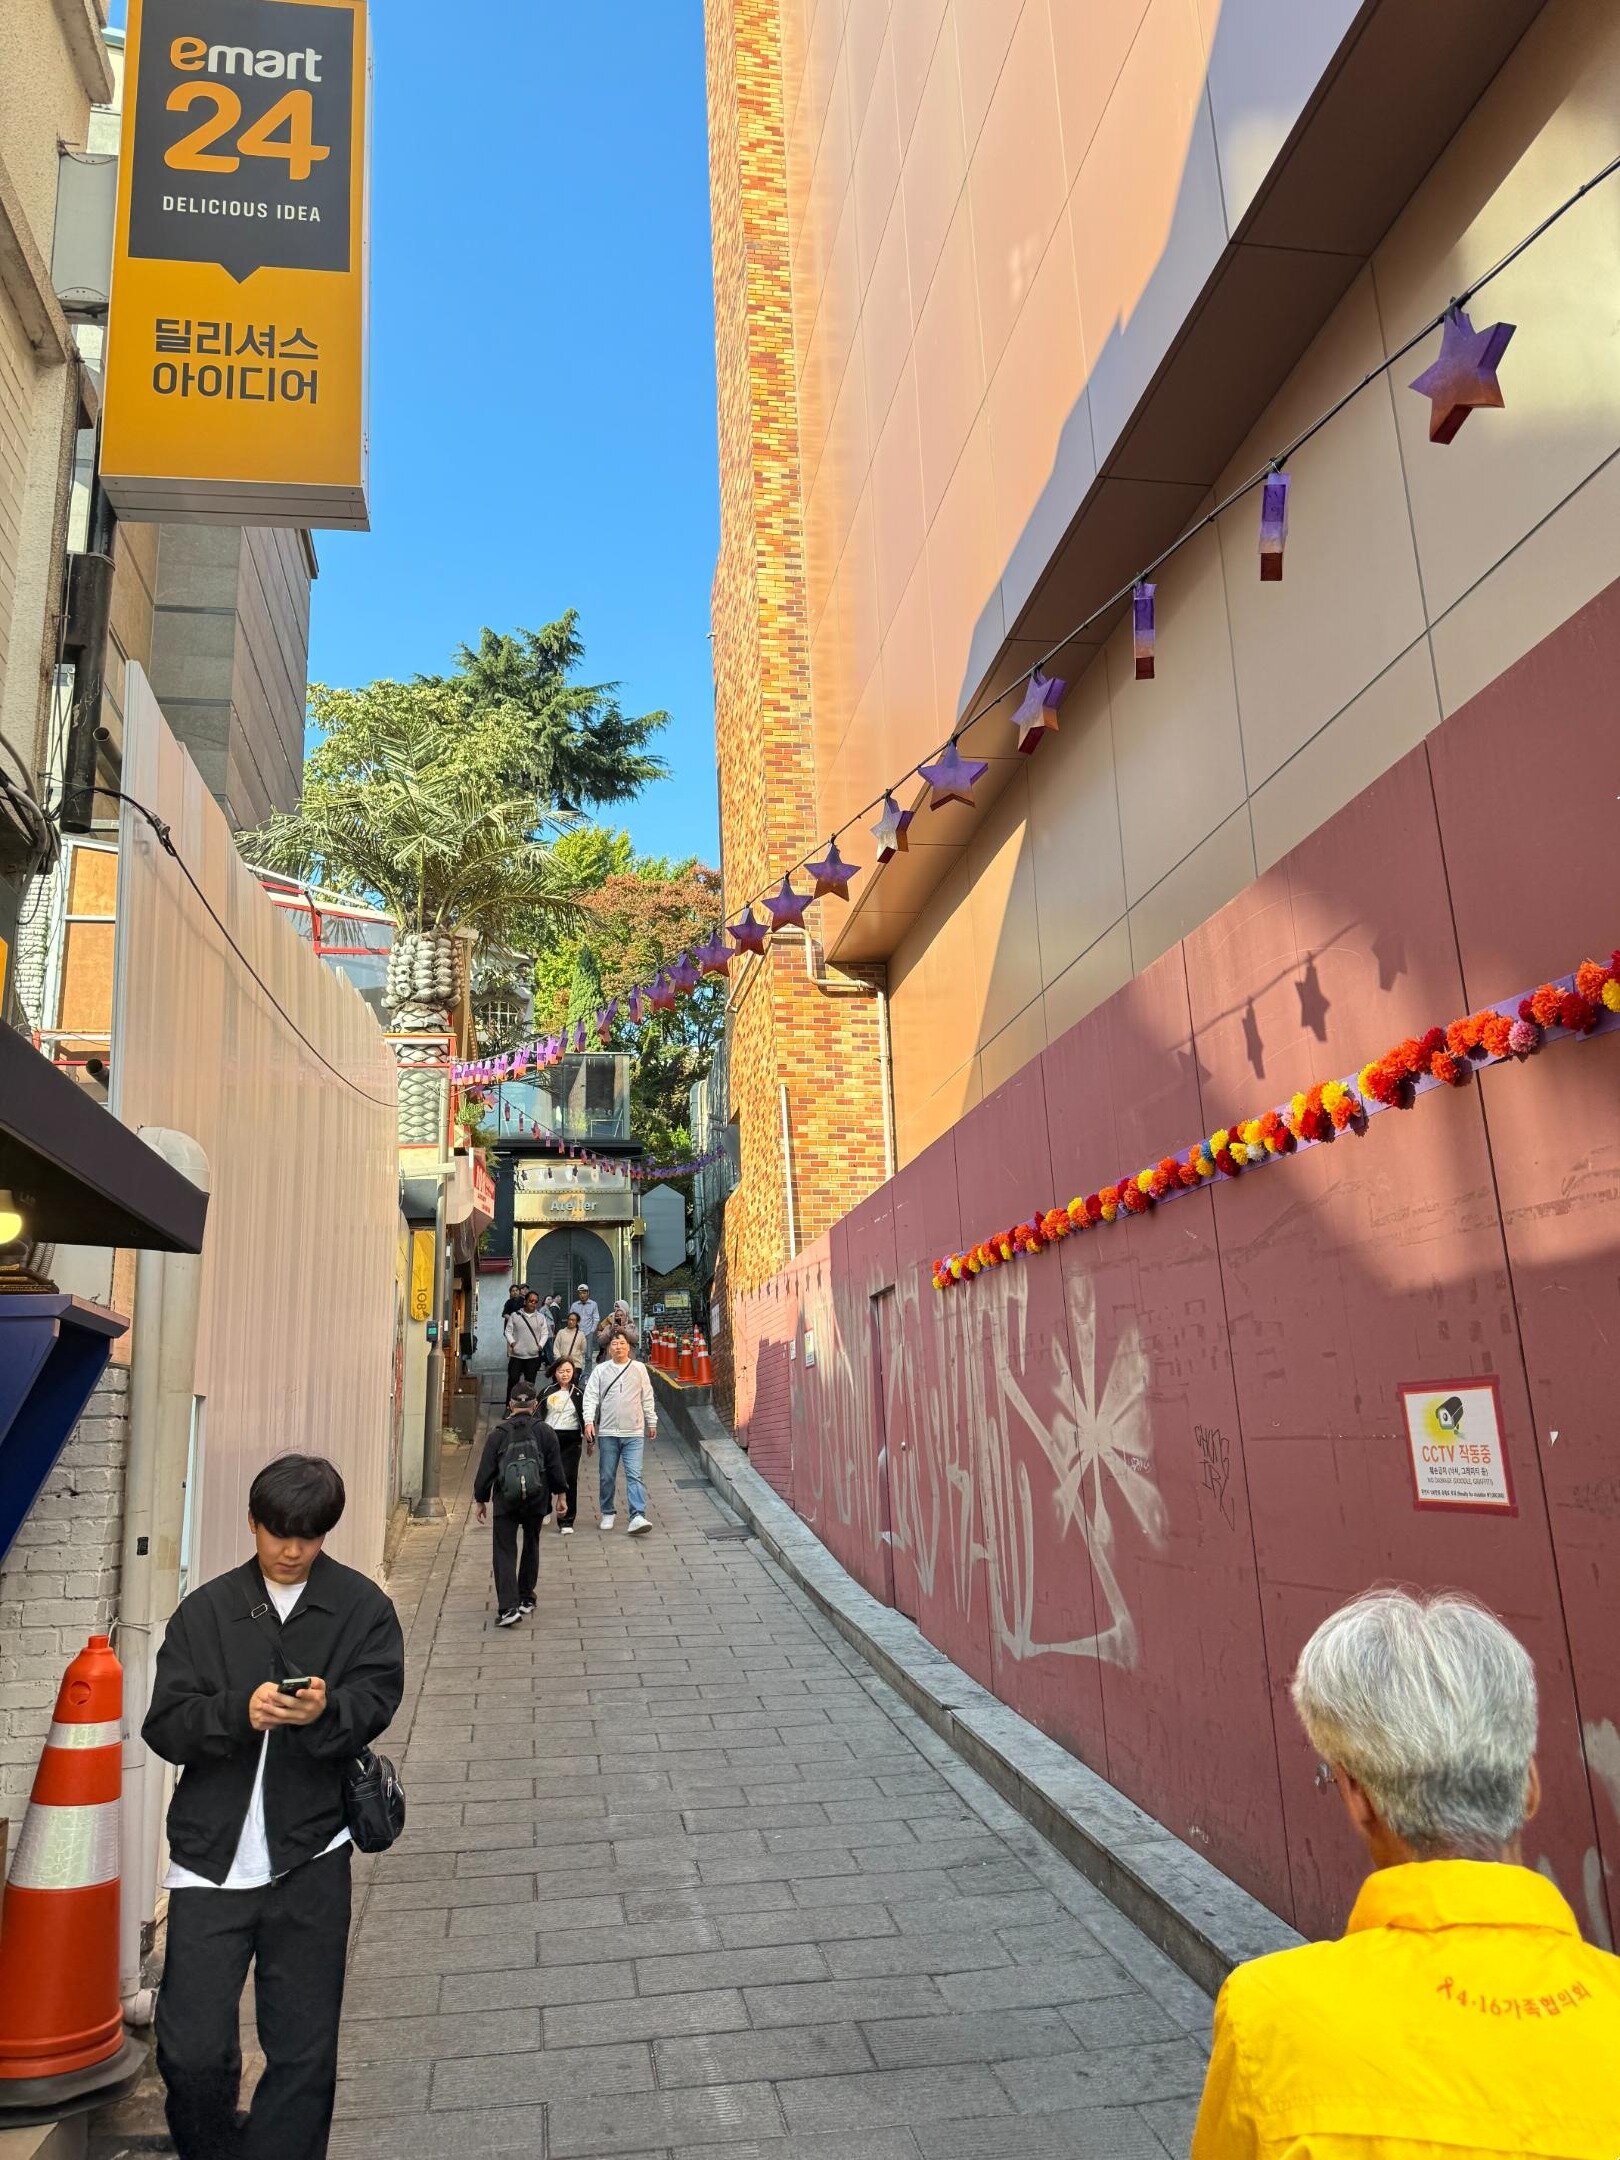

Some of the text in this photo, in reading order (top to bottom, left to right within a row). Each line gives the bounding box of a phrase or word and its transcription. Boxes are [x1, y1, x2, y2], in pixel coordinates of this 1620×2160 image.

[170, 36, 322, 83] emart
[164, 80, 331, 181] 24
[163, 196, 322, 223] DELICIOUS IDEA
[155, 318, 319, 361] 딜리셔스
[152, 362, 318, 405] 아이디어
[1422, 1444, 1492, 1465] CCTV 작동중
